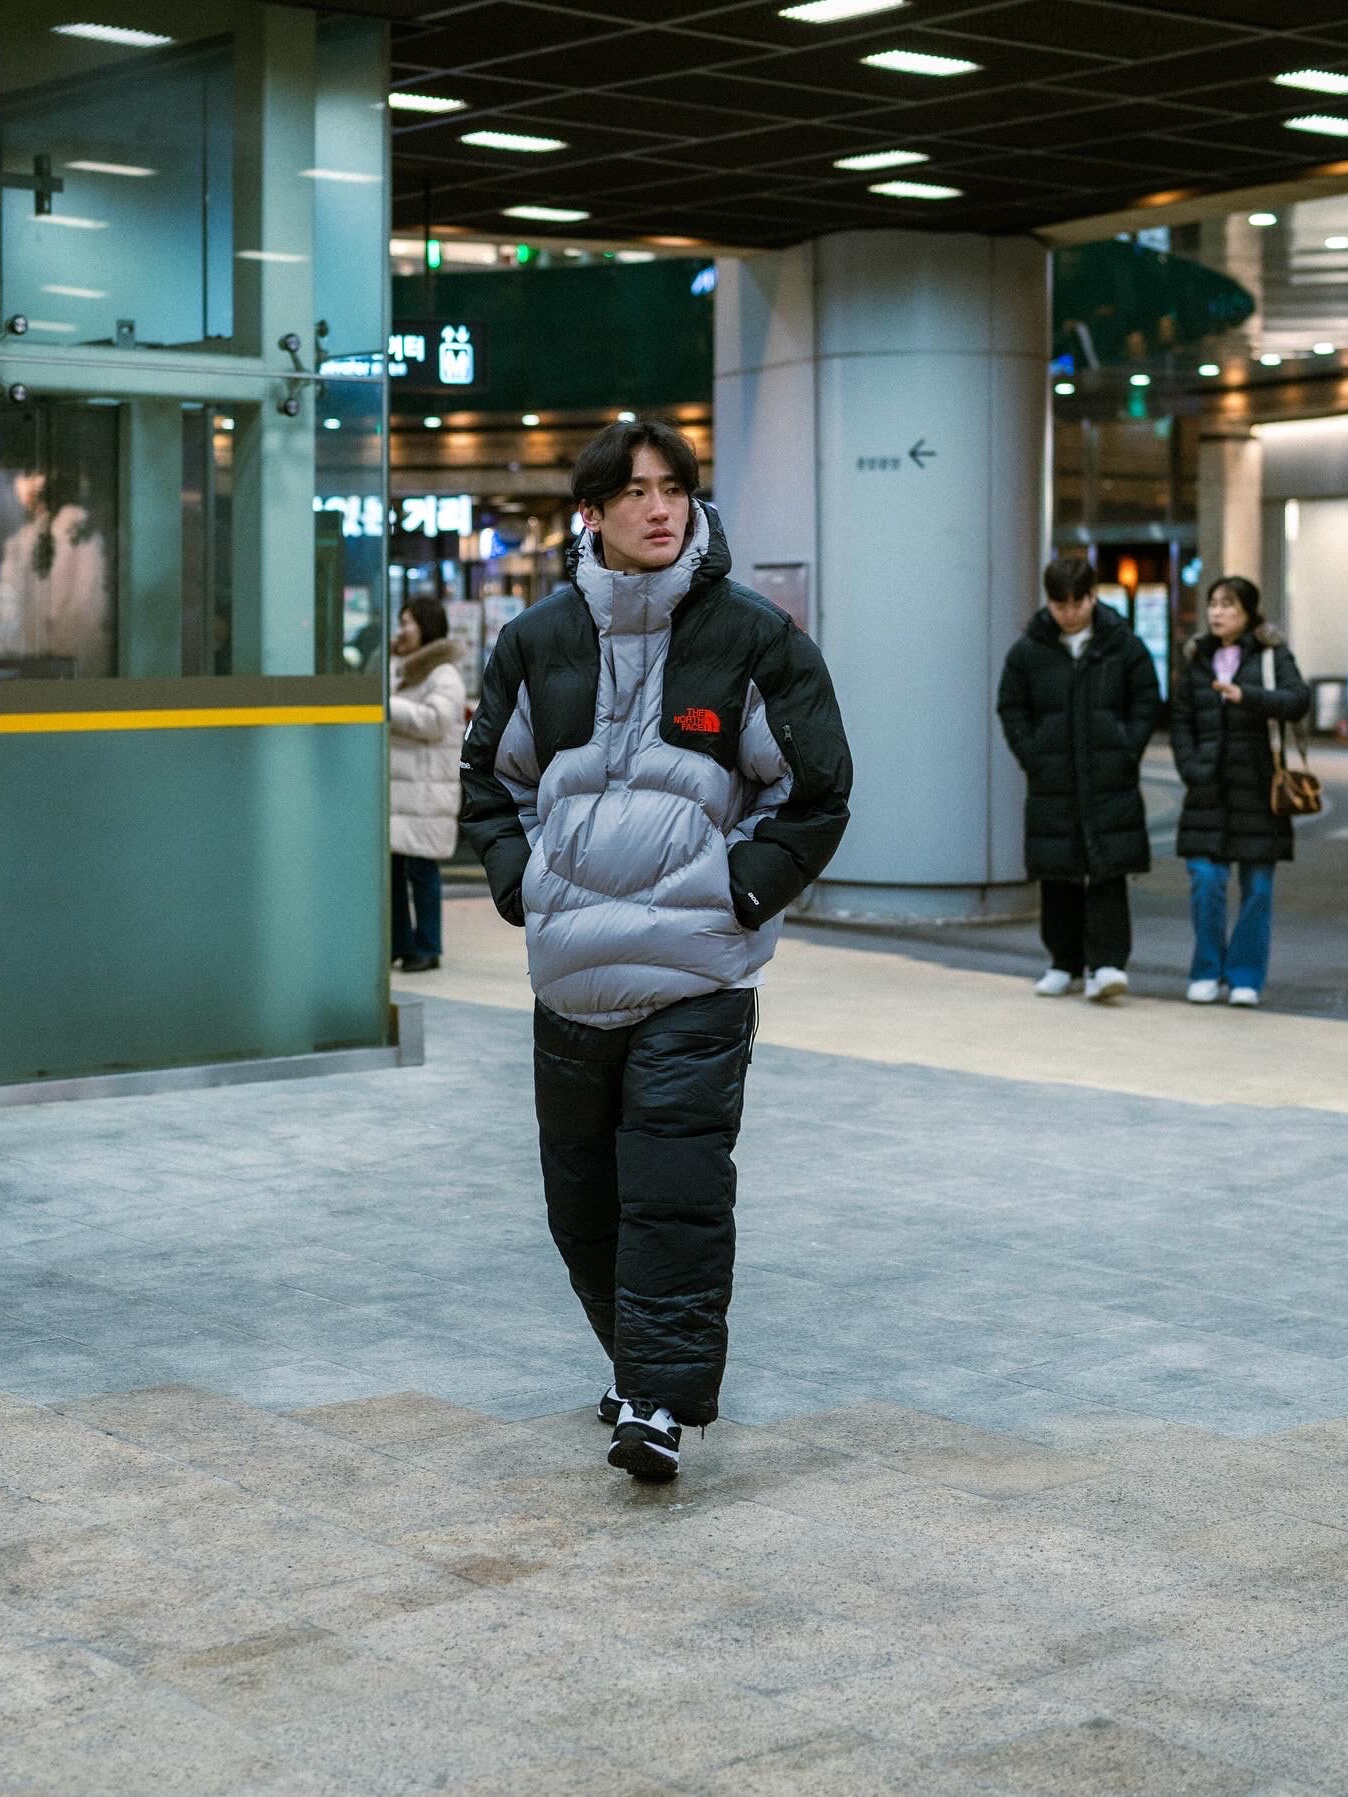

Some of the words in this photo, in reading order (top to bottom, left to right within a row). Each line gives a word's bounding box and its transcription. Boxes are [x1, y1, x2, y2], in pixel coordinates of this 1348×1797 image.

[402, 495, 473, 537] 거리
[686, 707, 705, 717] THE
[673, 715, 704, 724] NORTH
[681, 723, 706, 732] FACE
